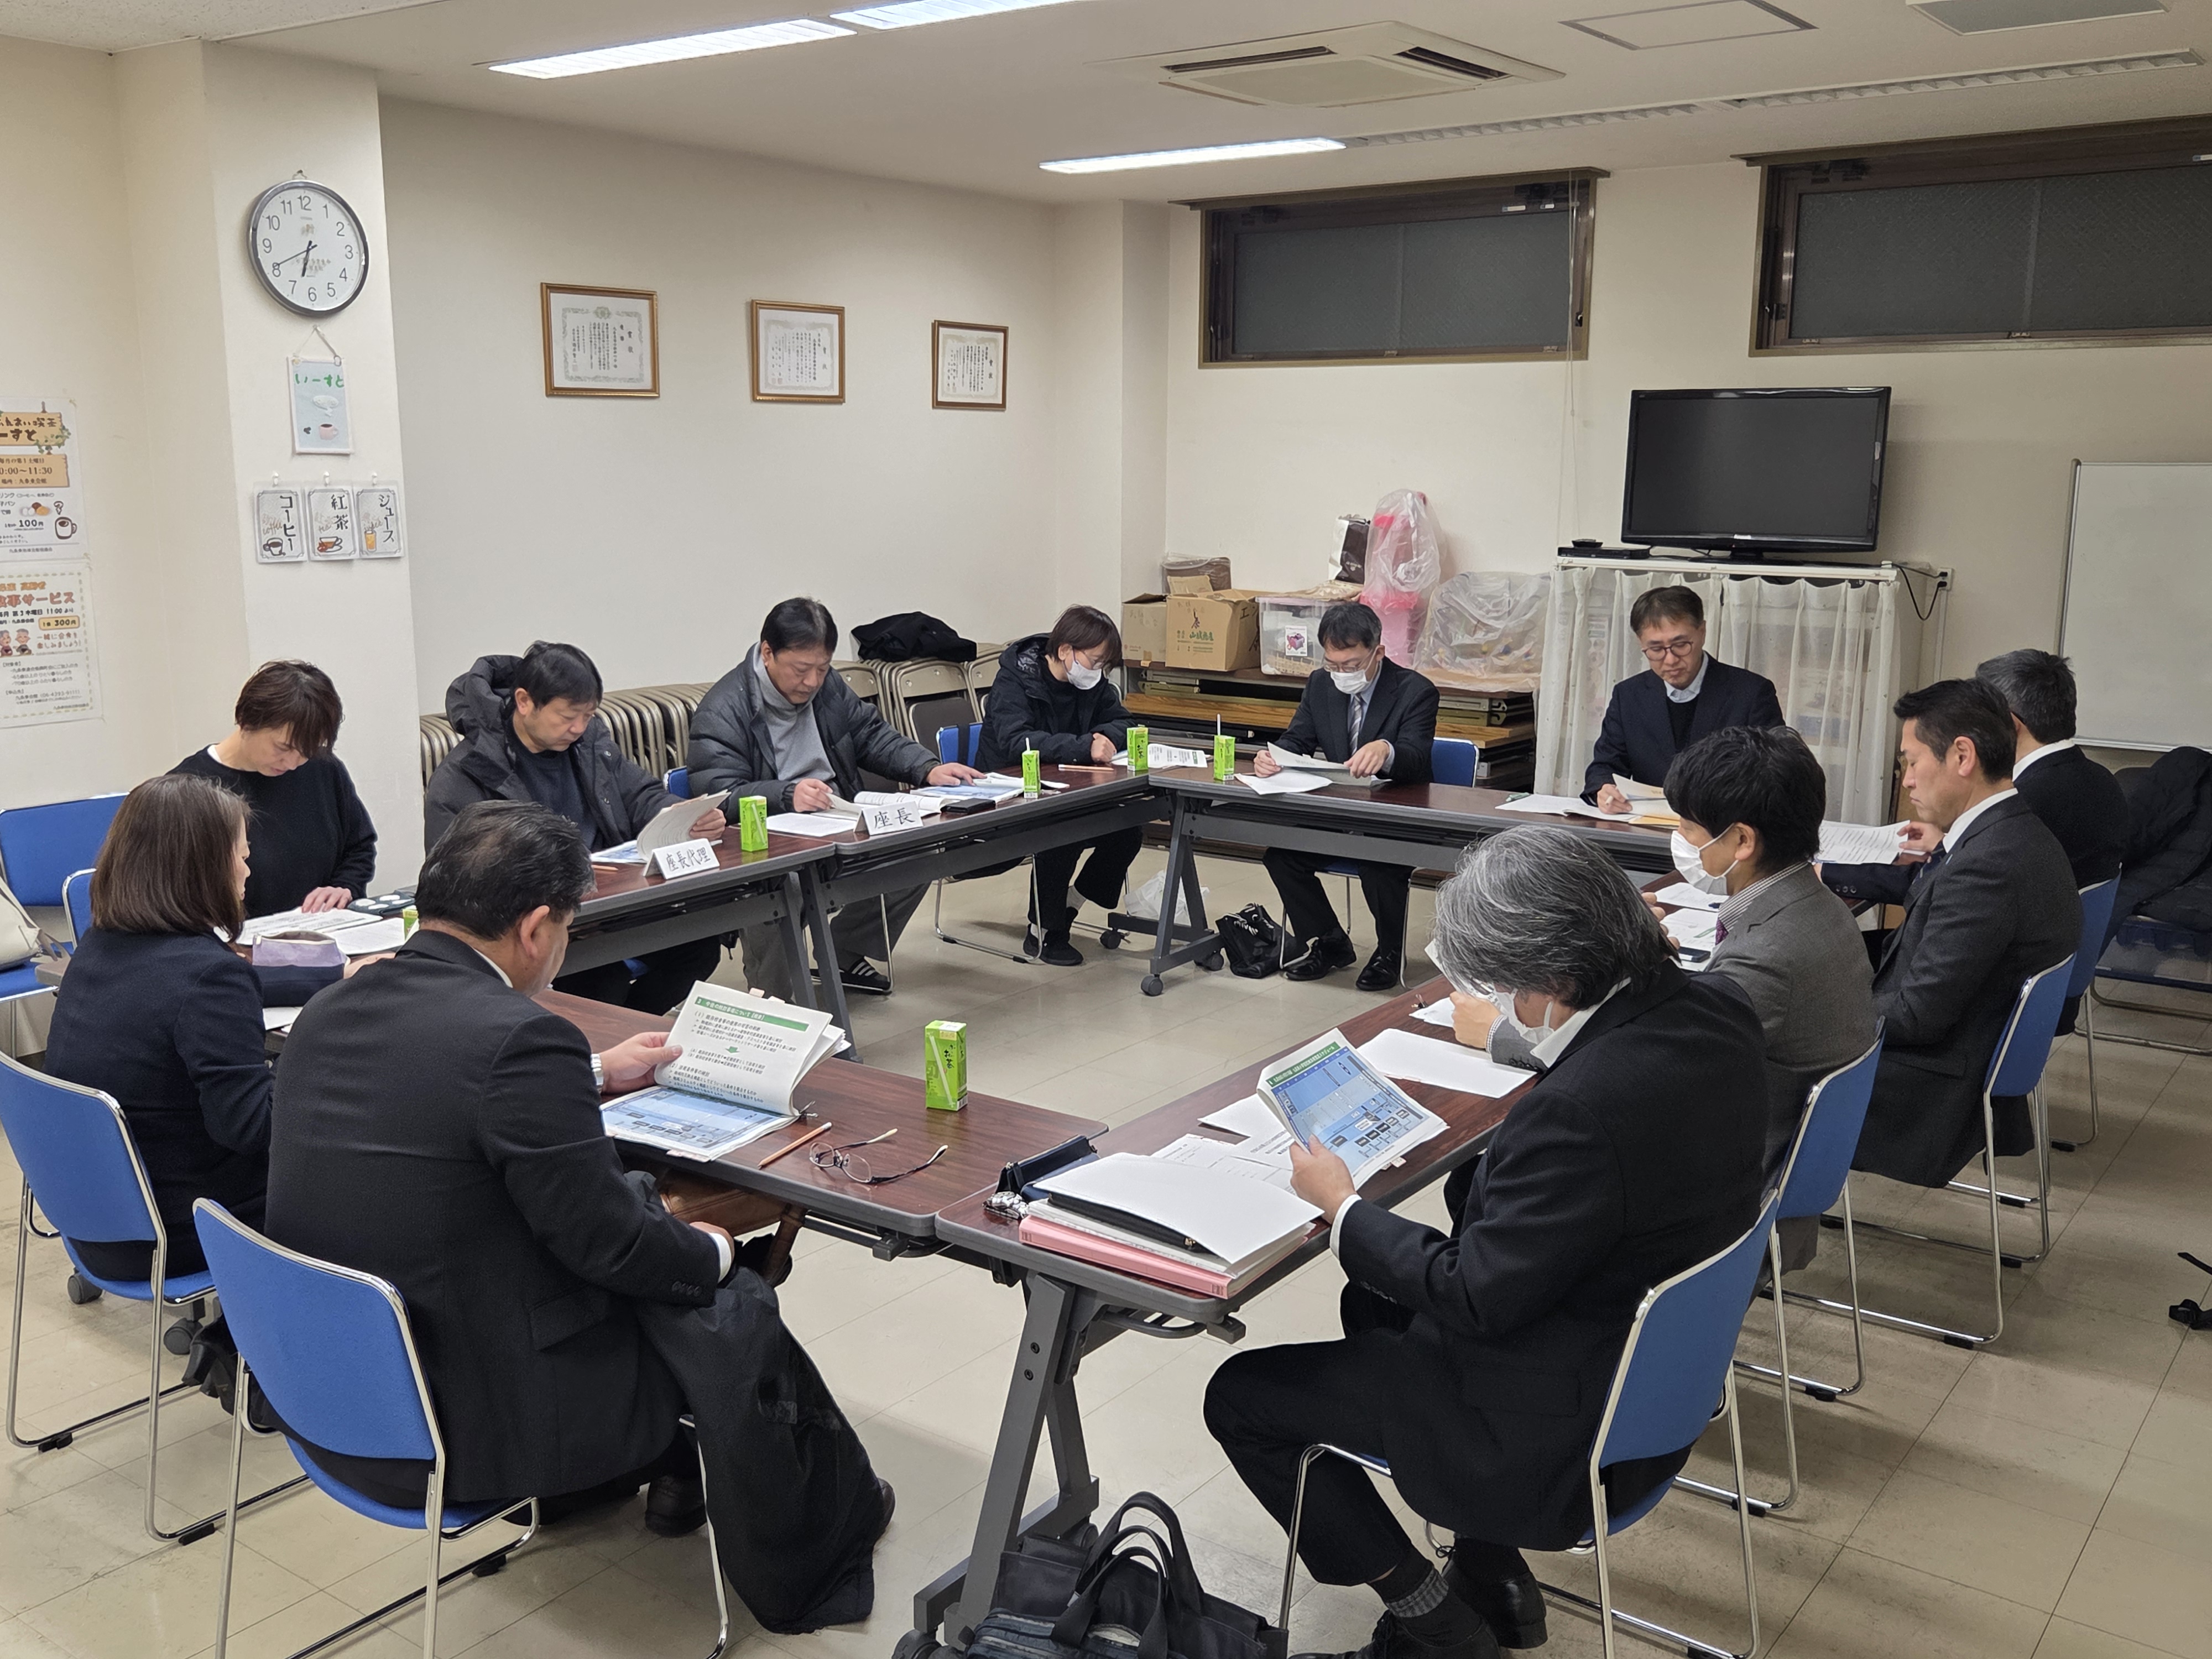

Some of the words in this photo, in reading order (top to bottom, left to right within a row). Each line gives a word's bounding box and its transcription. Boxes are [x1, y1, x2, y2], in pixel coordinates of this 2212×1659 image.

[280, 200, 293, 215] 11
[298, 195, 311, 211] 12
[322, 204, 328, 218] 1
[265, 215, 280, 231] 10
[336, 222, 345, 236] 2
[262, 238, 272, 253] 9
[345, 244, 353, 259] 3
[272, 262, 281, 277] 8
[339, 268, 348, 281] 4
[289, 280, 297, 294] 7
[308, 287, 317, 301] 6
[327, 283, 336, 297] 5
[295, 373, 344, 388] いーすと
[331, 494, 348, 530] 紅茶
[378, 495, 394, 542] ジュース
[280, 495, 296, 551] コーヒー
[874, 807, 916, 829] 座長
[666, 847, 711, 872] 座長代理
